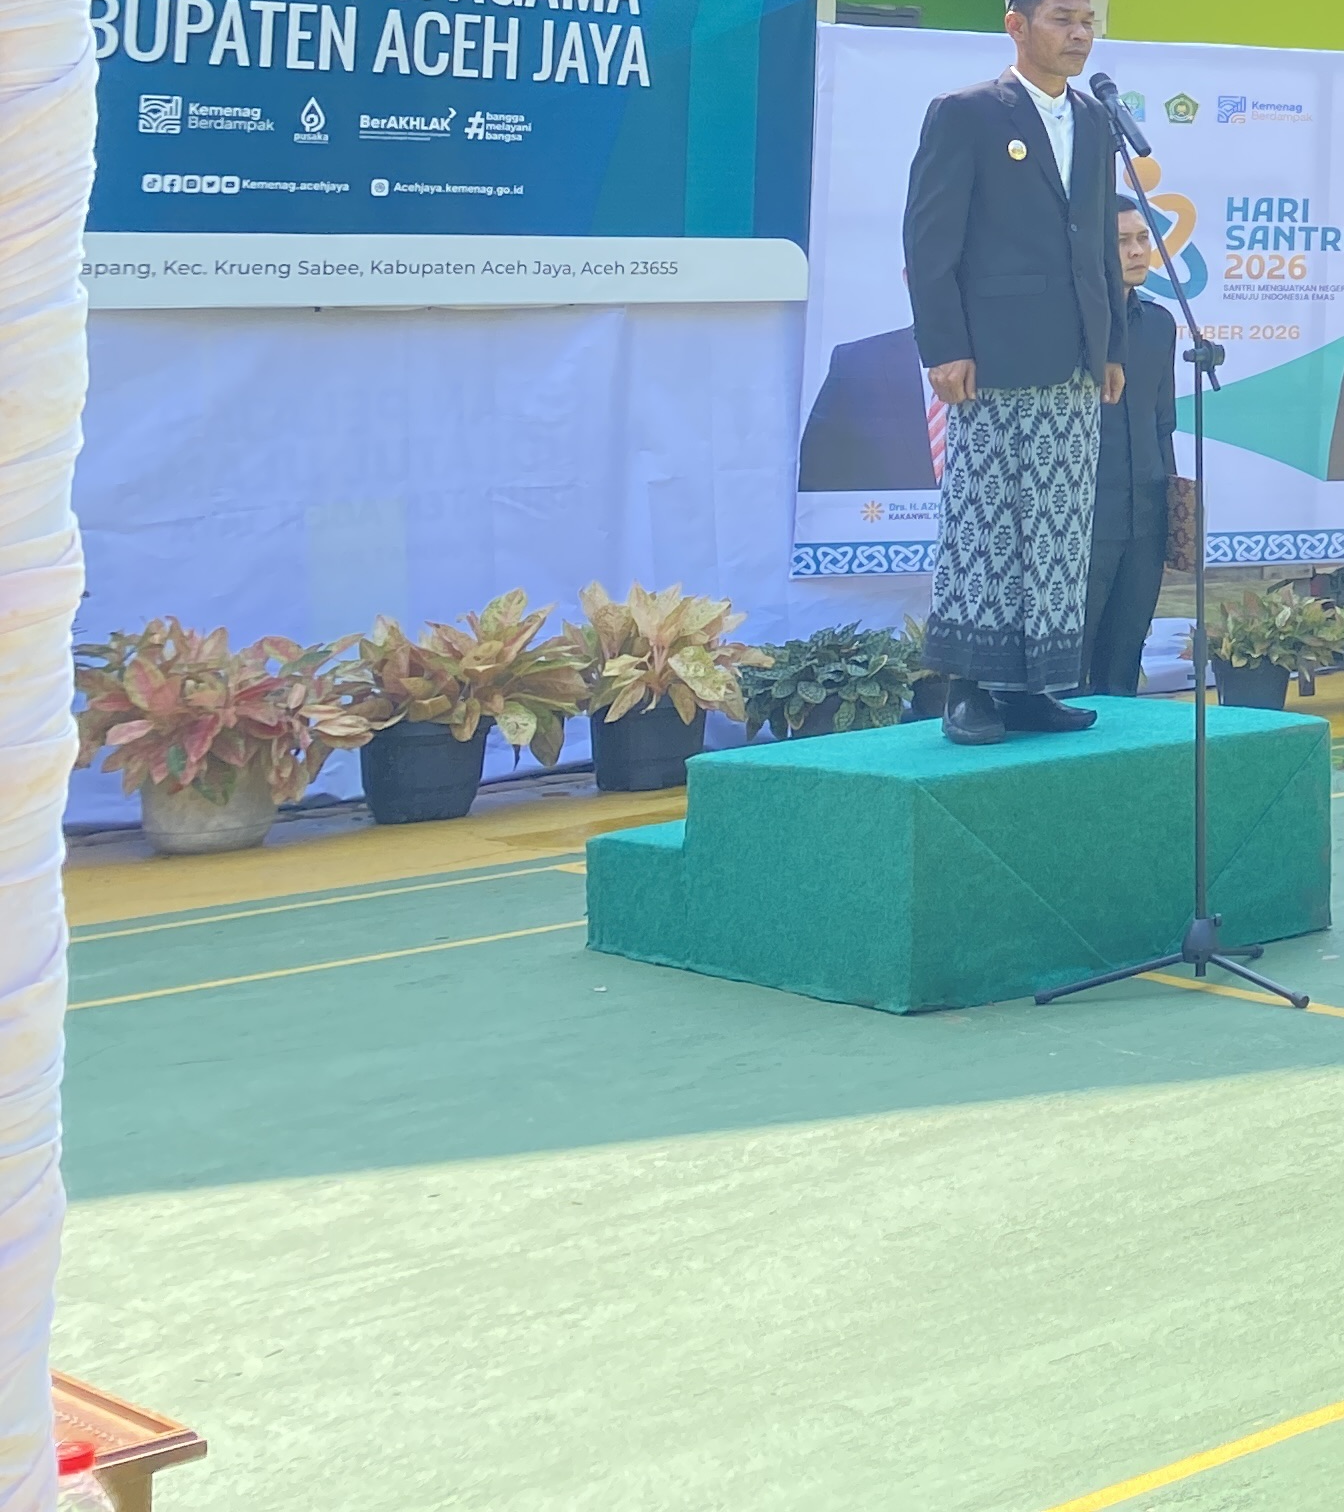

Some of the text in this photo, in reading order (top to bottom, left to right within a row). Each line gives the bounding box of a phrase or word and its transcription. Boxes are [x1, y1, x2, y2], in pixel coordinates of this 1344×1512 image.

[372, 8, 519, 80] ACEH
[532, 19, 651, 87] JAYA
[188, 102, 262, 120] Kemenag
[1251, 100, 1303, 113] Kemenag
[359, 114, 451, 131] BerAKHLAK
[486, 112, 525, 123] bangga
[1251, 111, 1313, 123] Berdampak
[188, 117, 275, 133] Berdampak
[485, 122, 532, 133] melayani
[293, 133, 329, 141] pusaka
[485, 131, 523, 143] bangsa
[242, 179, 350, 193] Kemenag.acehjaya
[394, 182, 525, 196] Acehjaya.kemenag.go.id
[1226, 196, 1310, 223] HARI
[82, 259, 679, 279] apang, Kec. Krueng Sabee, Kabupaten Aceh Jaya, Aceh 23655
[1223, 253, 1308, 280] 2026
[1223, 284, 1256, 292] SANTRI
[1257, 284, 1317, 293] MENGUATKAN
[1222, 293, 1336, 301] MENUJU INDONESIA EMAS
[1249, 325, 1300, 340] 2026
[921, 502, 940, 511] AZH
